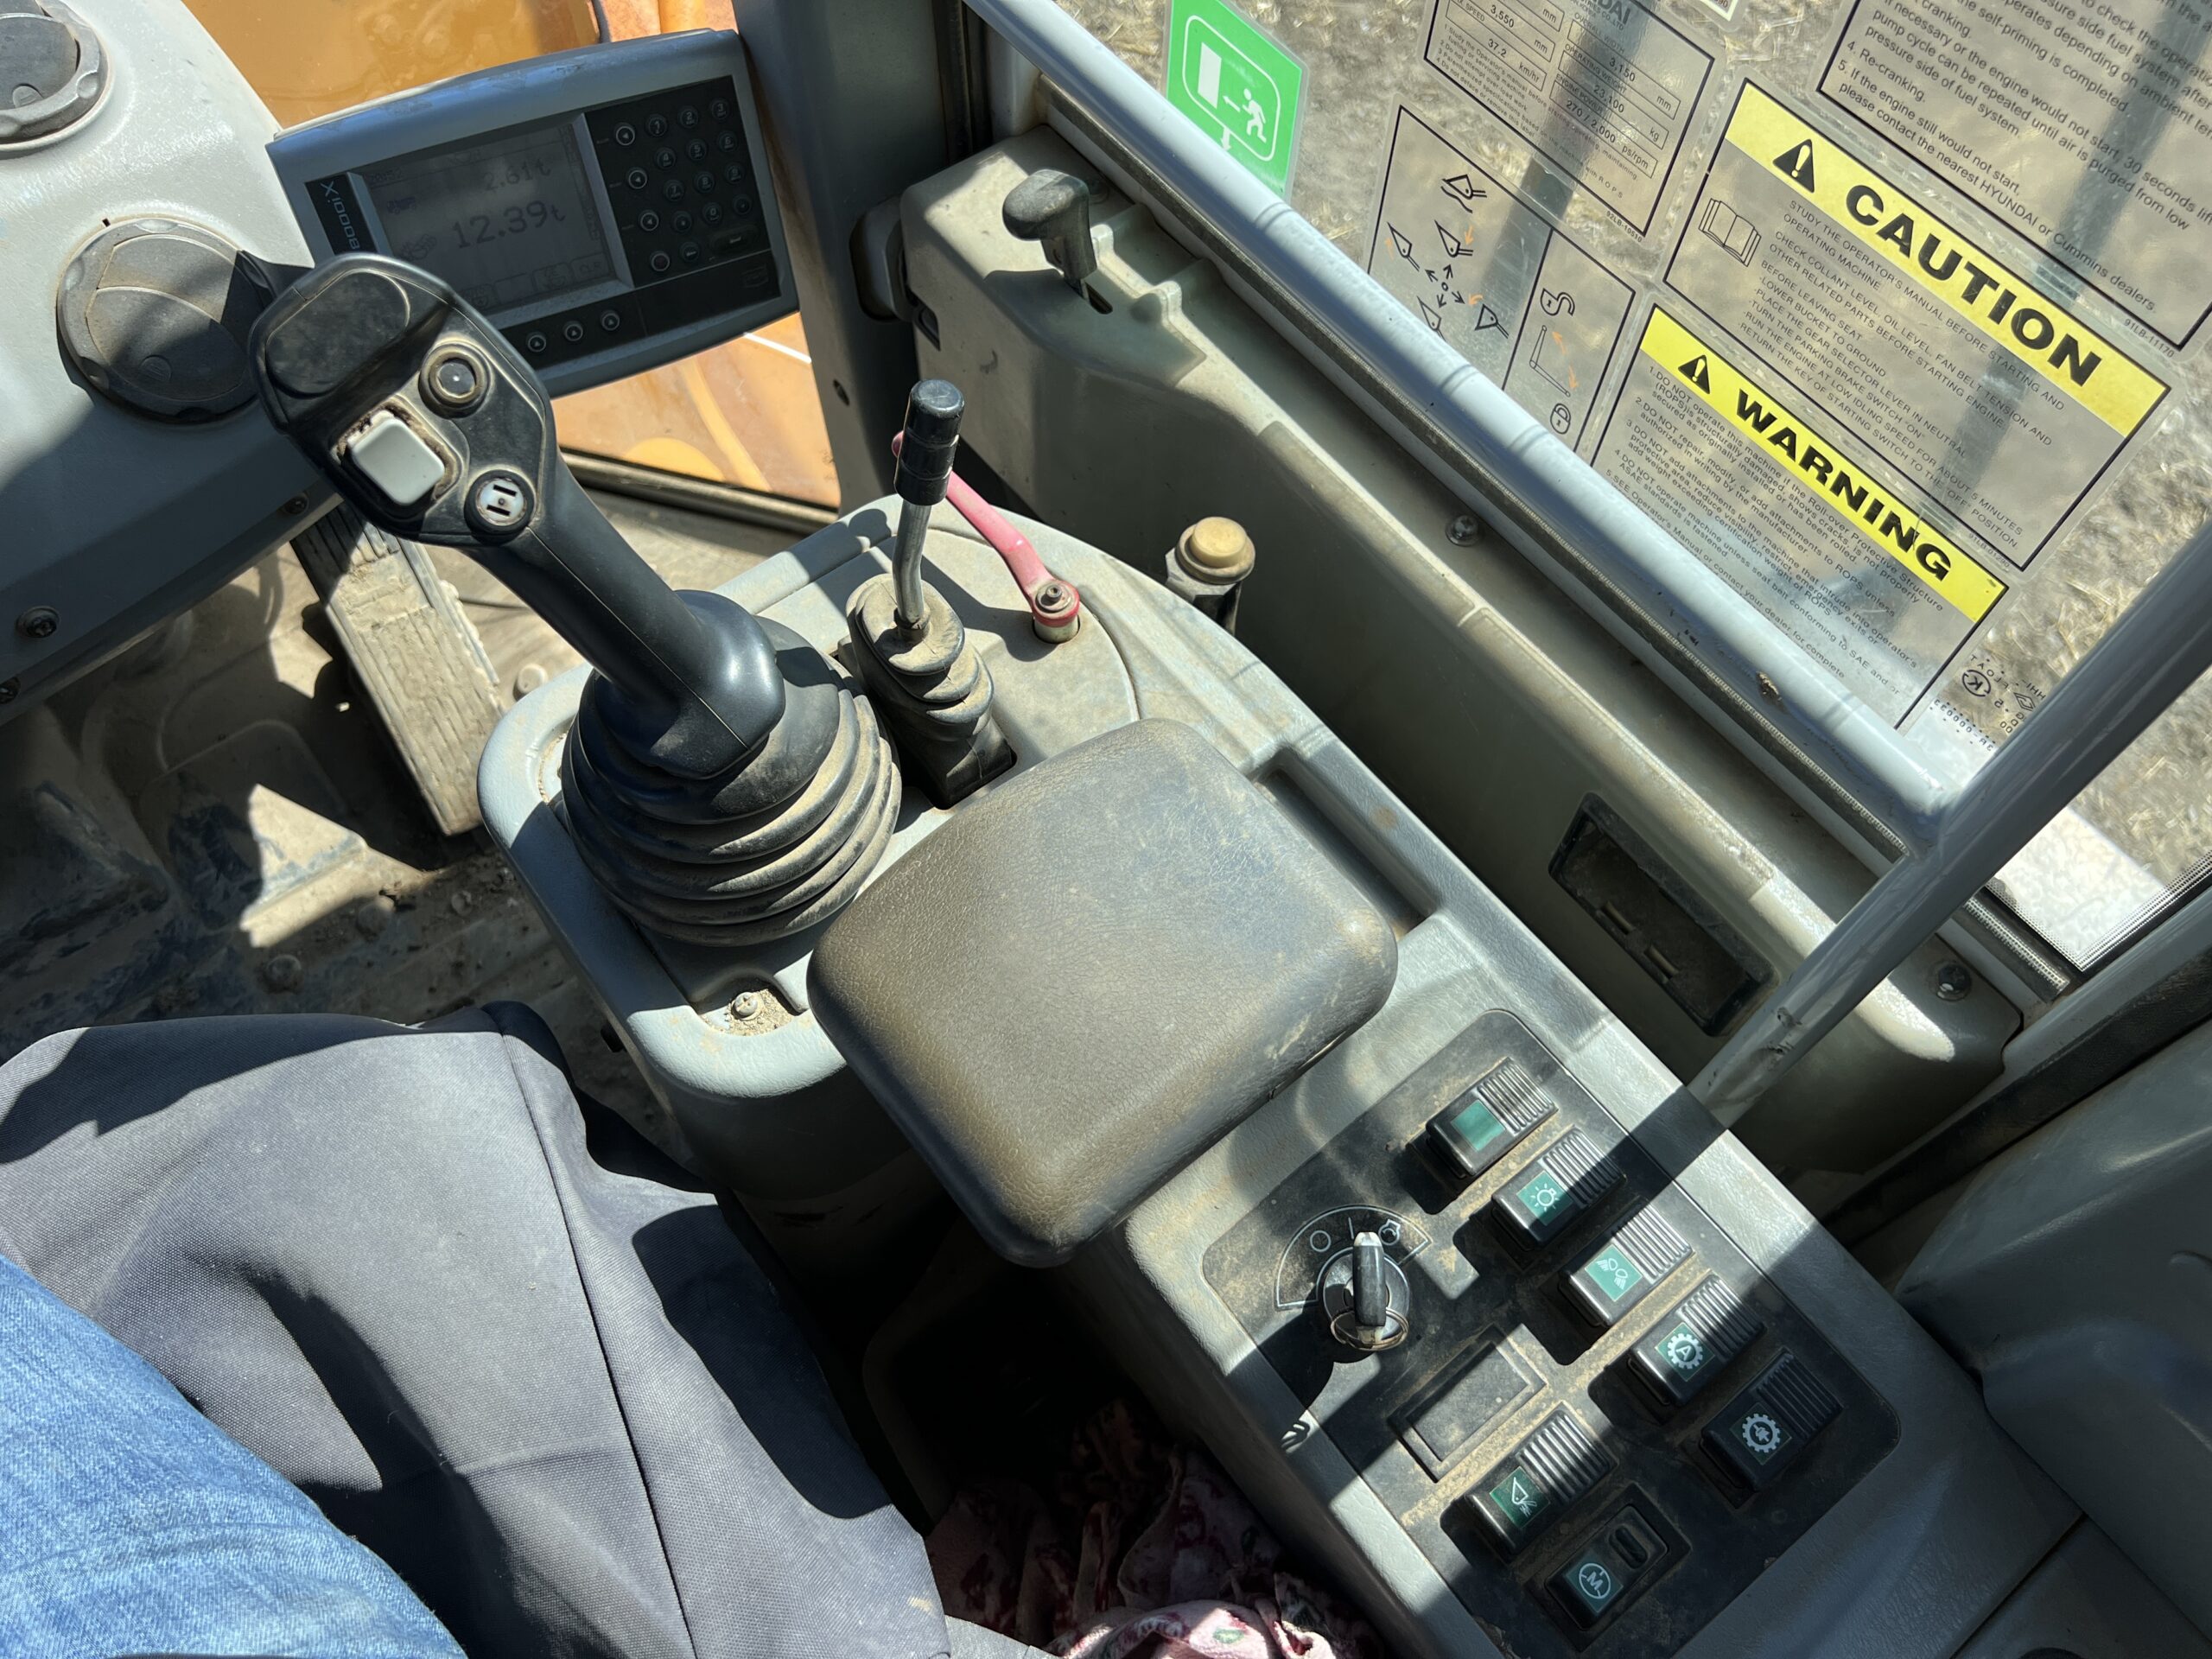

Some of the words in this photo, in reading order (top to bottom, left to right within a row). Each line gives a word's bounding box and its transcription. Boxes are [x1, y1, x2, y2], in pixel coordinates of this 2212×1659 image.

[1465, 2, 1484, 22] SPEED
[1490, 3, 1515, 30] 3,550
[1533, 37, 1548, 56] mm
[1541, 7, 1556, 24] mm
[1919, 0, 1975, 41] cranking.
[1976, 4, 2050, 61] self-priming
[2046, 51, 2063, 70] is
[1487, 36, 1507, 59] 37.2
[1518, 61, 1539, 85] km/hr
[1608, 55, 1636, 84] 3,150
[1656, 92, 1672, 112] mm
[1844, 37, 1859, 57] 4.
[1858, 47, 1929, 105] Re-cranking.
[1864, 22, 1915, 66] pressure
[1913, 57, 1941, 83] side
[1939, 74, 1955, 93] of
[1952, 83, 1978, 108] fuel
[1975, 99, 2024, 140] system.
[1565, 98, 1583, 118] 270
[1590, 118, 1616, 144] 2,000
[1621, 143, 1649, 171] ps/rpm
[1592, 82, 1624, 115] 23,100
[1648, 126, 1660, 143] kg
[1835, 57, 1851, 77] 5.
[1848, 67, 1859, 83] If
[1858, 73, 1878, 97] the
[1877, 86, 1917, 124] engine
[1915, 113, 1938, 137] still
[1936, 127, 1973, 162] would
[1970, 152, 1993, 176] not
[1872, 7, 1906, 39] pump
[1904, 29, 1937, 60] cycle
[1936, 50, 1960, 75] can
[1959, 67, 1978, 87] be
[1975, 78, 2031, 123] repeated
[2029, 114, 2058, 143] until
[2056, 134, 2076, 156] air
[2074, 147, 2090, 164] is
[2088, 156, 2135, 195] purged
[2133, 187, 2166, 216] from
[2163, 207, 2191, 232] low
[1892, 0, 1953, 49] necessary
[1951, 39, 1967, 59] or
[1965, 48, 1988, 73] the
[1986, 62, 2031, 101] engine
[2028, 91, 2068, 126] would
[2066, 118, 2090, 141] not
[2120, 155, 2143, 176] 30
[2140, 168, 2199, 213] seconds
[1838, 80, 1876, 115] please
[1874, 105, 1916, 143] contact
[1915, 135, 1936, 157] the
[1935, 149, 1980, 188] nearest
[1978, 179, 2038, 228] HYUNDAI
[2036, 219, 2054, 239] or
[2050, 230, 2111, 279] Cummins
[2107, 270, 2162, 315] dealers.
[1783, 212, 1837, 257] OPERATING
[1836, 253, 1881, 292] MACHINE
[1840, 176, 2103, 389] CAUTION
[1760, 259, 1797, 293] BEFORE
[1797, 288, 1837, 323] LEAVING
[1836, 319, 1863, 343] SEAT
[1768, 242, 1801, 272] OTHER
[1801, 267, 1844, 305] RELATED
[1843, 300, 1875, 329] PARTS
[1875, 325, 1915, 359] BEFORE
[1915, 355, 1965, 398] STARTING
[1774, 229, 1808, 260] CHECK
[1807, 255, 1850, 293] COLLANT
[1882, 313, 1901, 332] OIL
[1934, 353, 1956, 374] FAN
[1955, 369, 1982, 394] BELT
[1981, 390, 2029, 429] TENSION
[2027, 425, 2052, 448] AND
[1789, 199, 1821, 228] STUDY
[1820, 223, 1841, 244] THE
[1840, 238, 1904, 290] OPERATOR'S
[1903, 285, 1946, 321] MANUAL
[1944, 316, 1987, 353] BEFORE
[1987, 349, 2041, 393] STARTING
[2039, 389, 2065, 412] AND
[1794, 302, 1831, 335] BUCKET
[1830, 331, 1845, 346] TO
[1845, 342, 1886, 378] GROUND
[1775, 319, 1794, 338] THE
[1794, 334, 1834, 370] PARKING
[1834, 365, 1866, 395] BRAKE
[1865, 391, 1903, 424] SWITCH
[1785, 311, 1804, 330] THE
[1803, 326, 1830, 351] GEAR
[1829, 346, 1879, 390] SELECTOR
[1878, 385, 1911, 415] LEVER
[1910, 410, 1923, 423] IN
[1922, 419, 1967, 459] NEUTRAL
[1657, 414, 1677, 436] NOT
[1738, 482, 1751, 496] or
[1750, 492, 1769, 512] add
[1768, 506, 1823, 557] attachments
[1822, 554, 1834, 566] to
[1834, 563, 1865, 591] ROPS
[1670, 384, 1692, 405] NOT
[1692, 401, 1726, 434] operate
[1726, 429, 1744, 448] this
[1744, 443, 1783, 480] machine
[1782, 475, 1791, 486] if
[1790, 482, 1807, 500] the
[1807, 496, 1850, 535] Roll-over
[1897, 571, 1945, 613] Structure
[1729, 388, 1956, 582] WARNING
[1675, 1345, 1691, 1362] A
[1586, 1571, 1603, 1591] M
